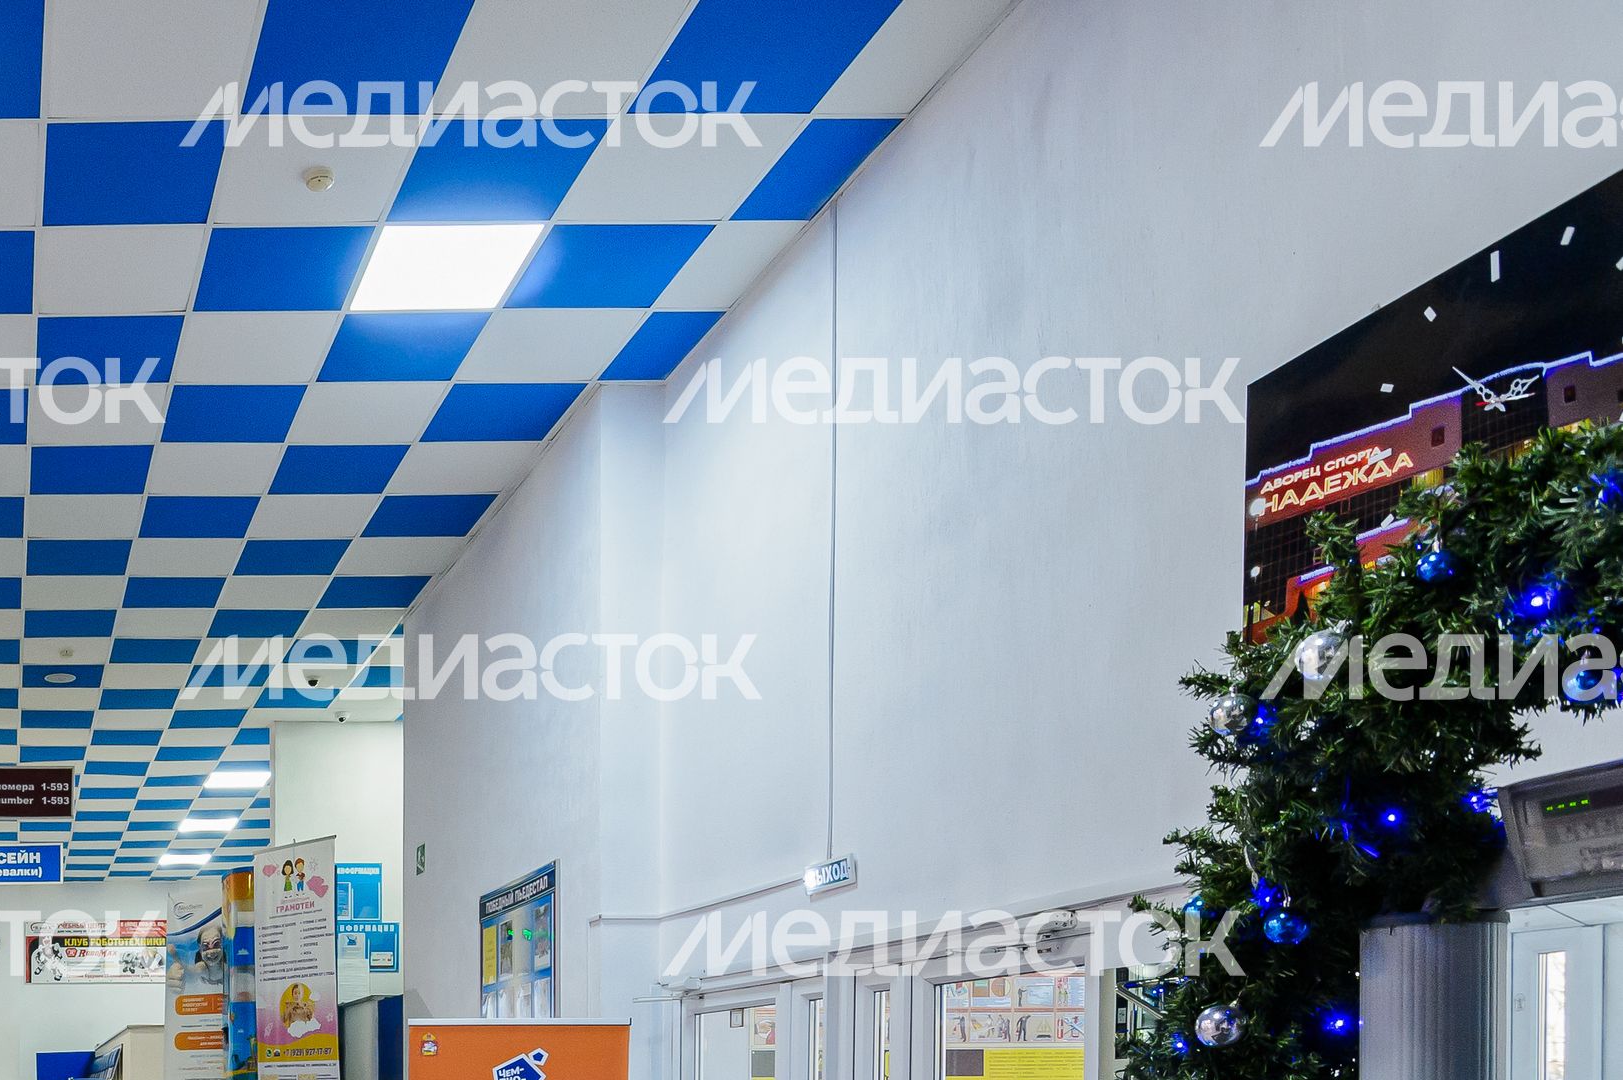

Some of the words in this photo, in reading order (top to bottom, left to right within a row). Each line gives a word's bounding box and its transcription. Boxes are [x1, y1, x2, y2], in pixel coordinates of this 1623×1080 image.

[1261, 465, 1321, 494] ДВОРЕЦ
[1324, 447, 1381, 472] СПОРТА
[1259, 453, 1413, 516] НАДЕЖДА
[41, 783, 69, 791] 1-593
[42, 797, 69, 805] 1-593
[809, 861, 849, 887] ЫХОД
[514, 875, 548, 902] ПЬЕДЕСТАЛ
[339, 924, 394, 932] НФОРМАЦИЯ
[90, 937, 165, 945] РОБОТОТЕХНИКИ
[499, 1066, 524, 1077] ЧЕМ-
